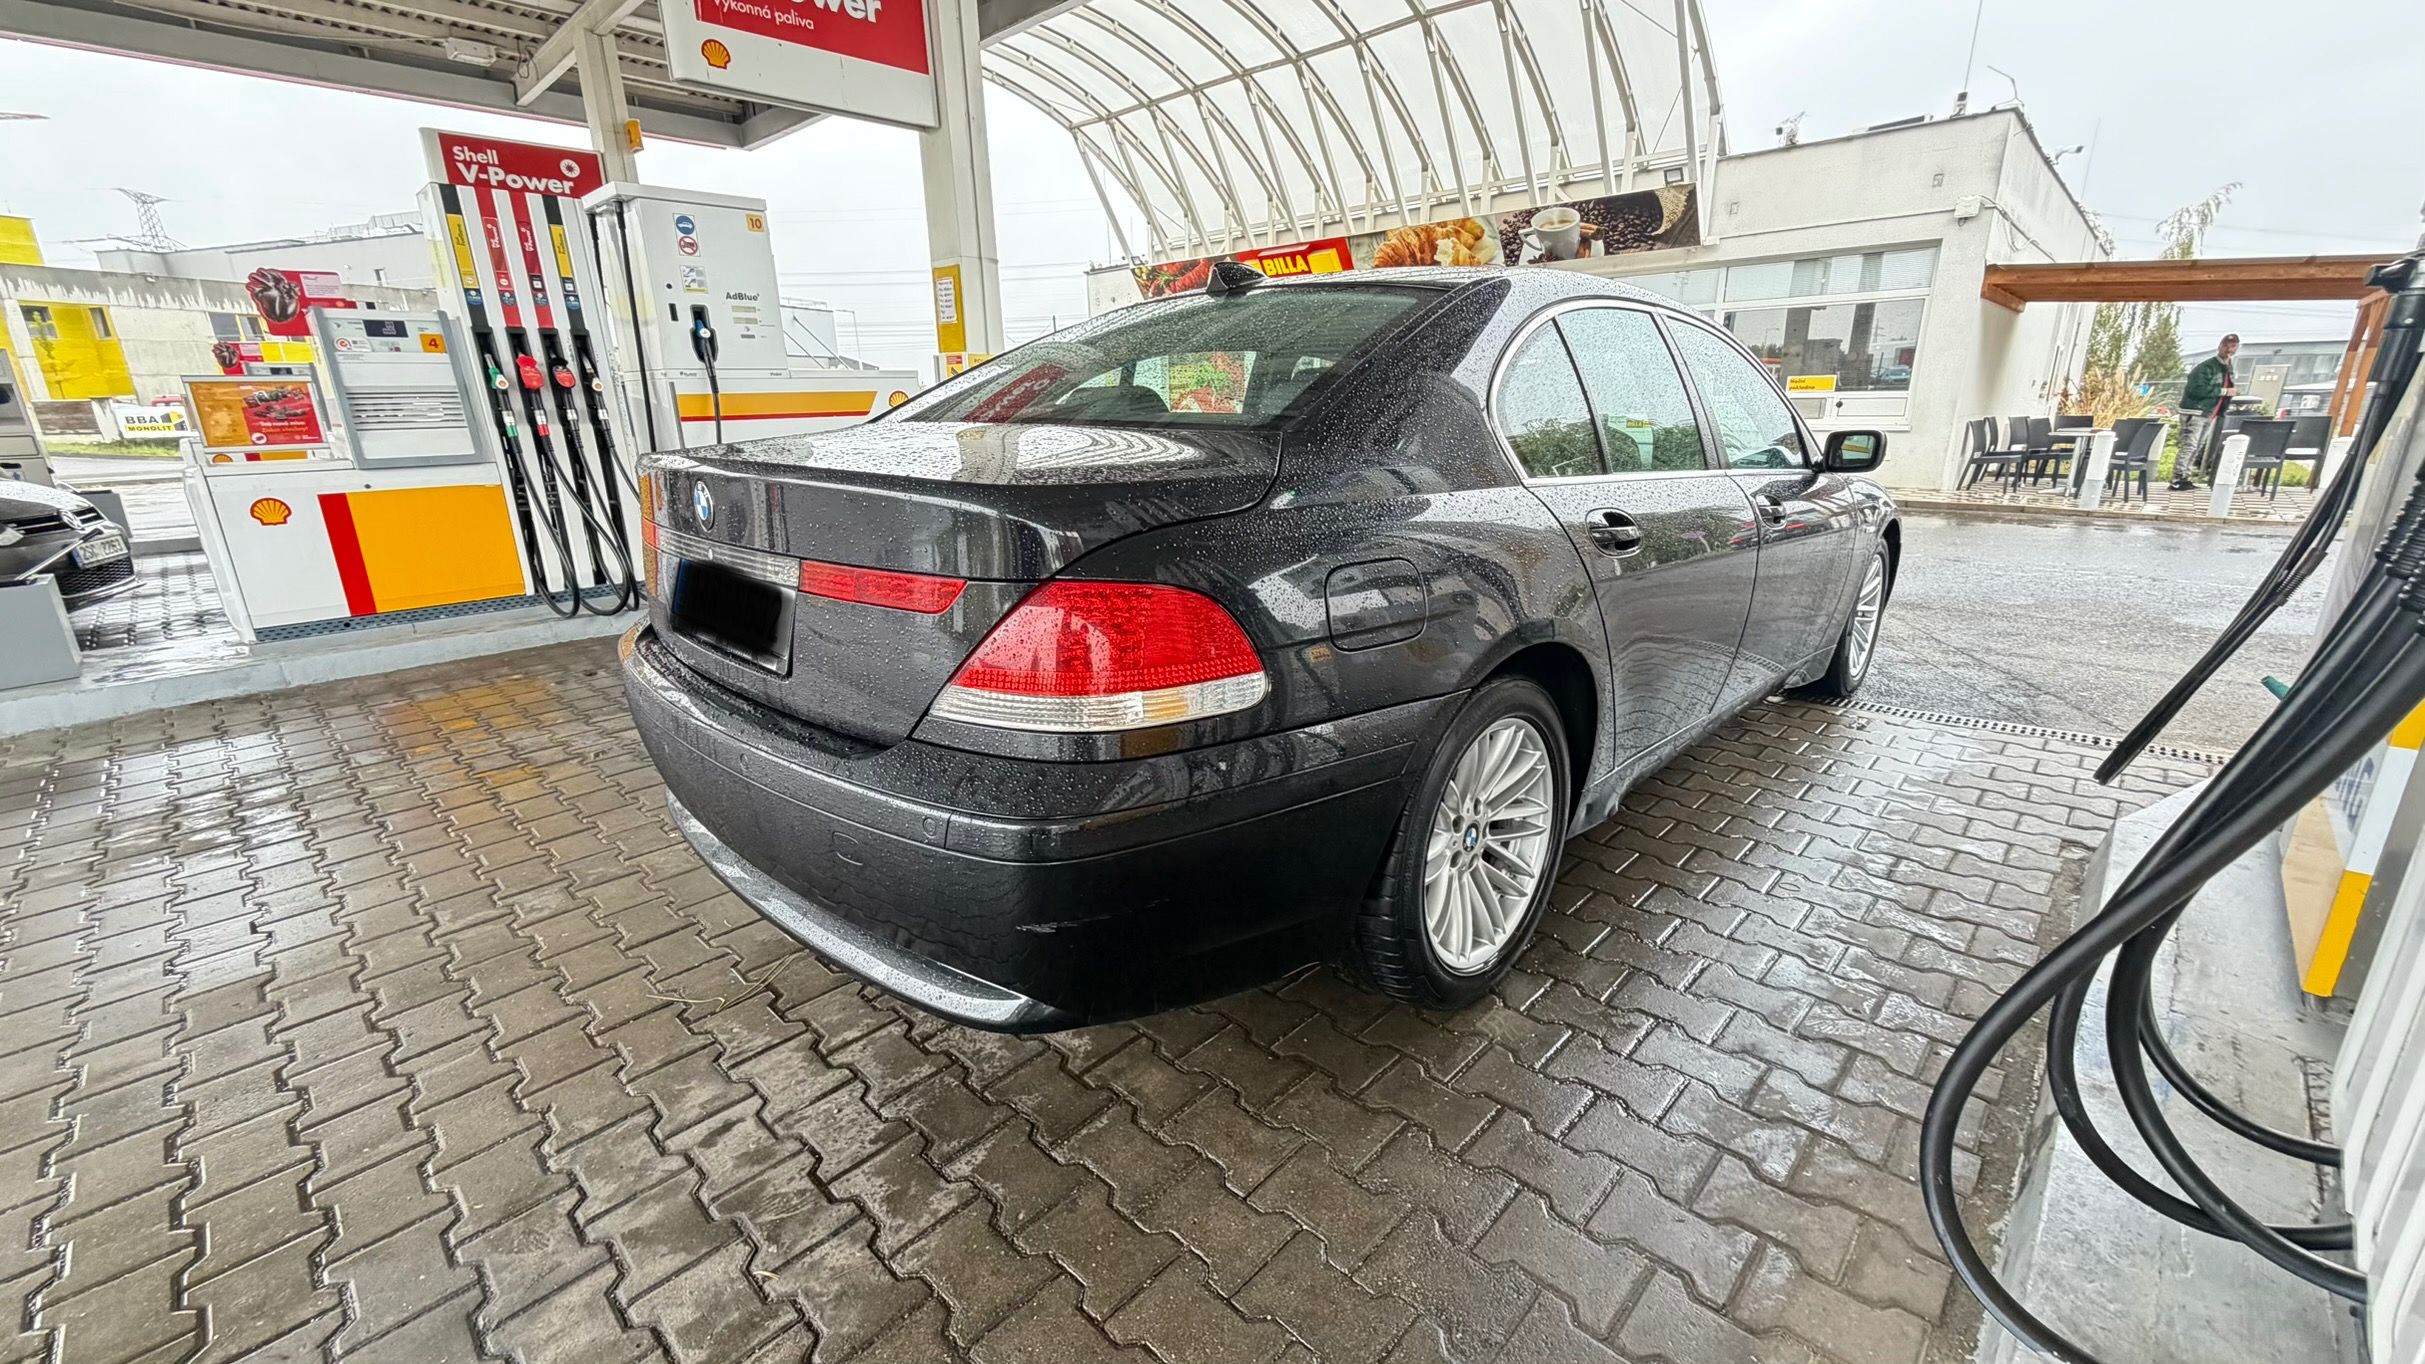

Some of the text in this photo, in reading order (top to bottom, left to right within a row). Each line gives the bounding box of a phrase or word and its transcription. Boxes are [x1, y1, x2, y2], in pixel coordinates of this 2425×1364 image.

[774, 9, 815, 29] paliva
[452, 146, 499, 165] Shell
[456, 162, 574, 194] V-Power
[749, 217, 762, 229] 10
[1262, 254, 1310, 276] BILLA
[428, 338, 439, 348] 4
[125, 416, 159, 424] BBA
